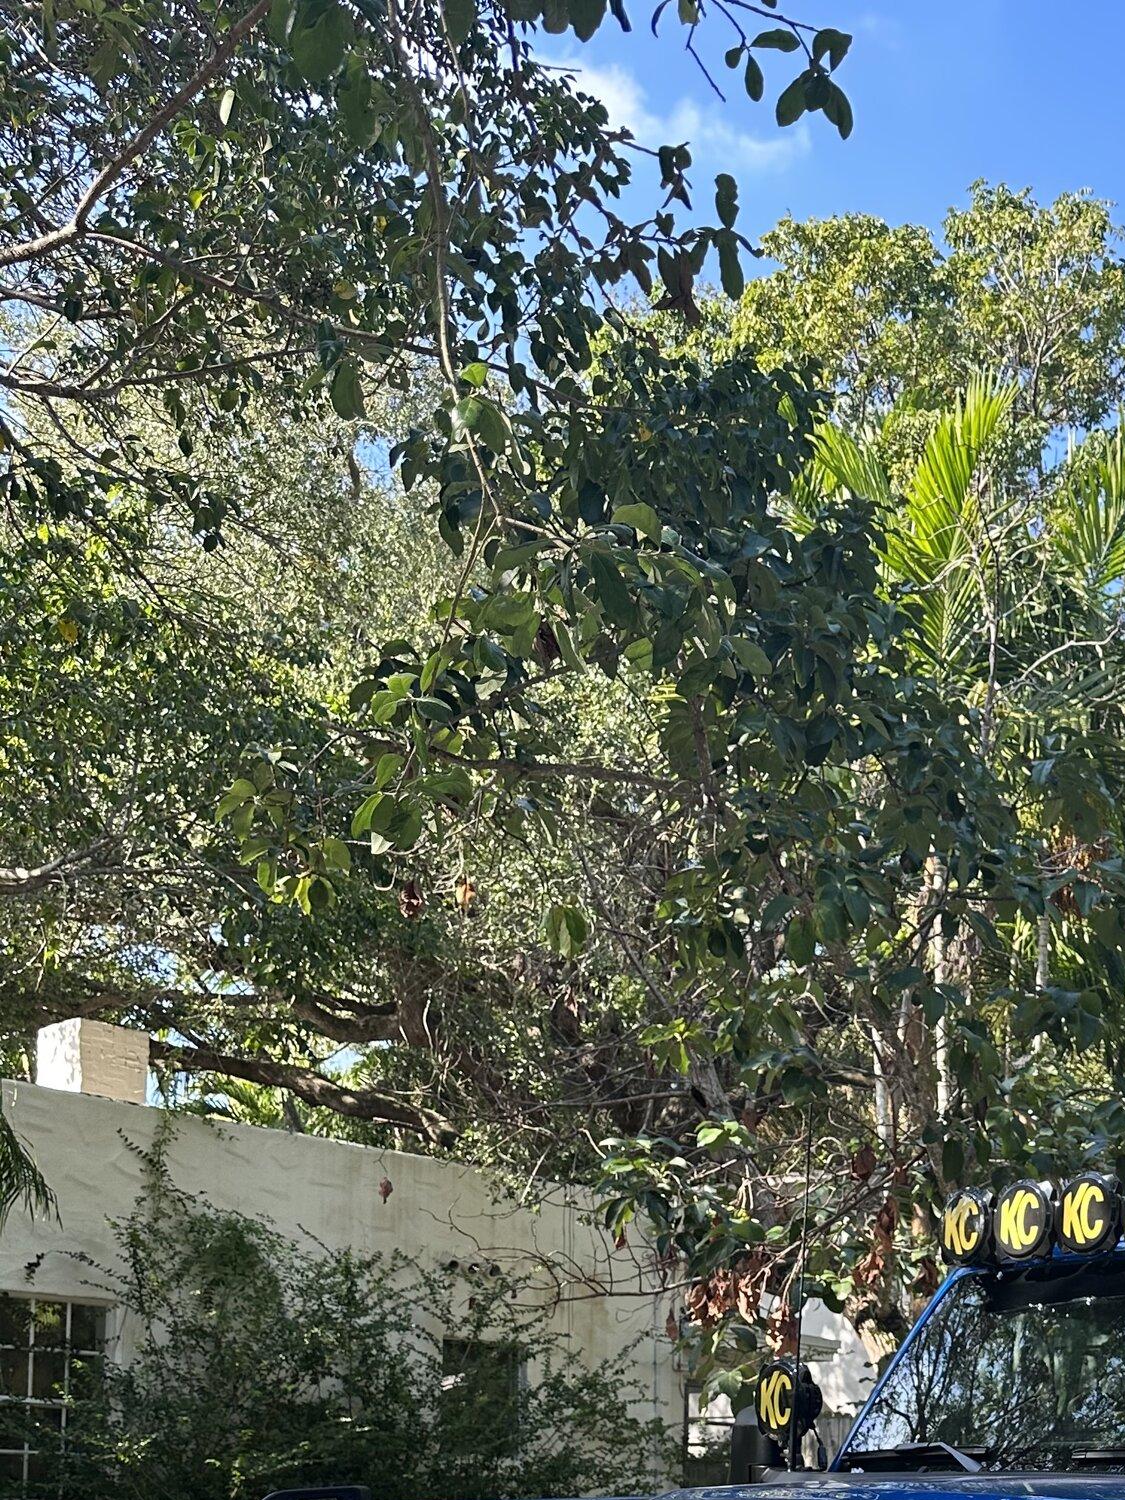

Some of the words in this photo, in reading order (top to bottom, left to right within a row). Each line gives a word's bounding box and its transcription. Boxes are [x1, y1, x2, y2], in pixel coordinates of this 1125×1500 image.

[944, 1197, 979, 1255] KC
[1000, 1189, 1039, 1250] KC
[1063, 1182, 1104, 1244] KC
[761, 1370, 792, 1430] KC
